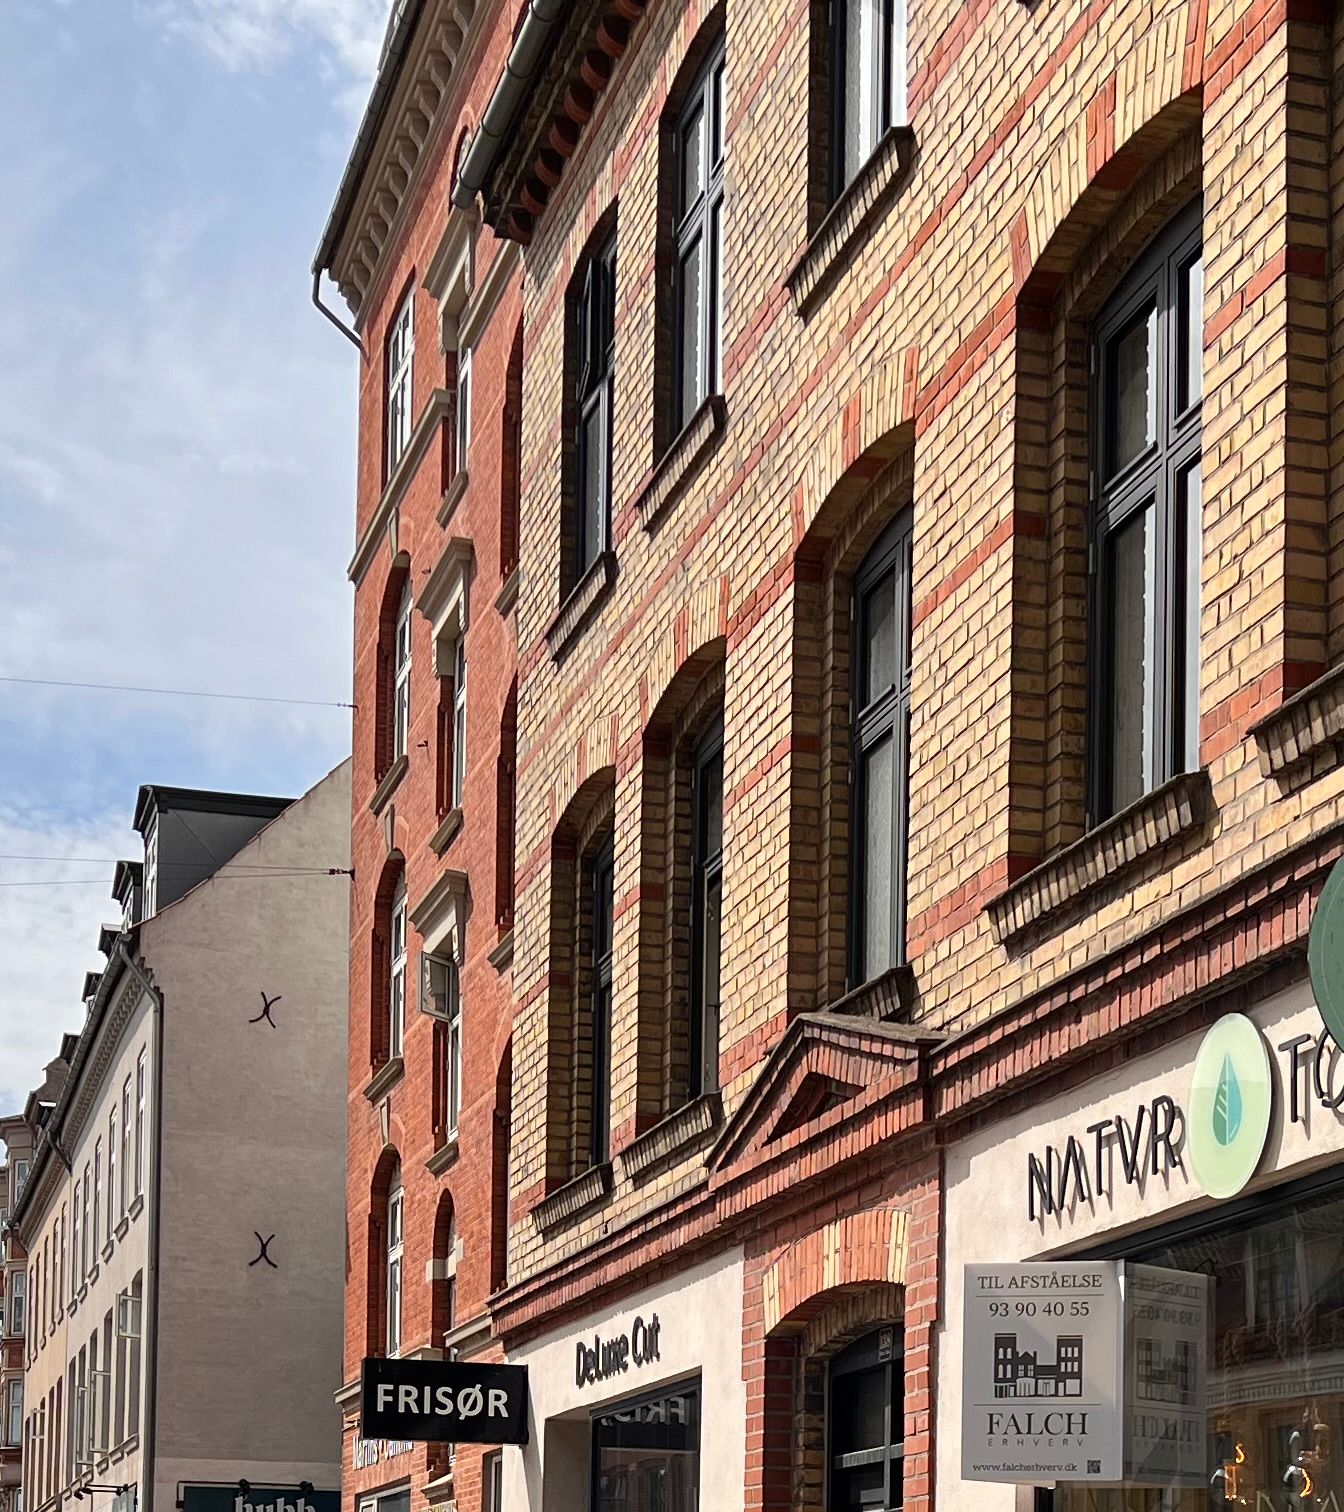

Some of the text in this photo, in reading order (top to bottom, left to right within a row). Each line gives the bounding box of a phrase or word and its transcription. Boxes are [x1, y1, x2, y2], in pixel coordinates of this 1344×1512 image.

[977, 1270, 1103, 1289] TIL AFSTÅELSE
[989, 1301, 1090, 1317] 93 90 40 55
[632, 1313, 661, 1368] Cut
[376, 1383, 509, 1420] FRISØR
[986, 1412, 1089, 1436] FALCH
[988, 1438, 1085, 1447] ERHVERV
[972, 1462, 1078, 1472] www.falcherhverv.dk
